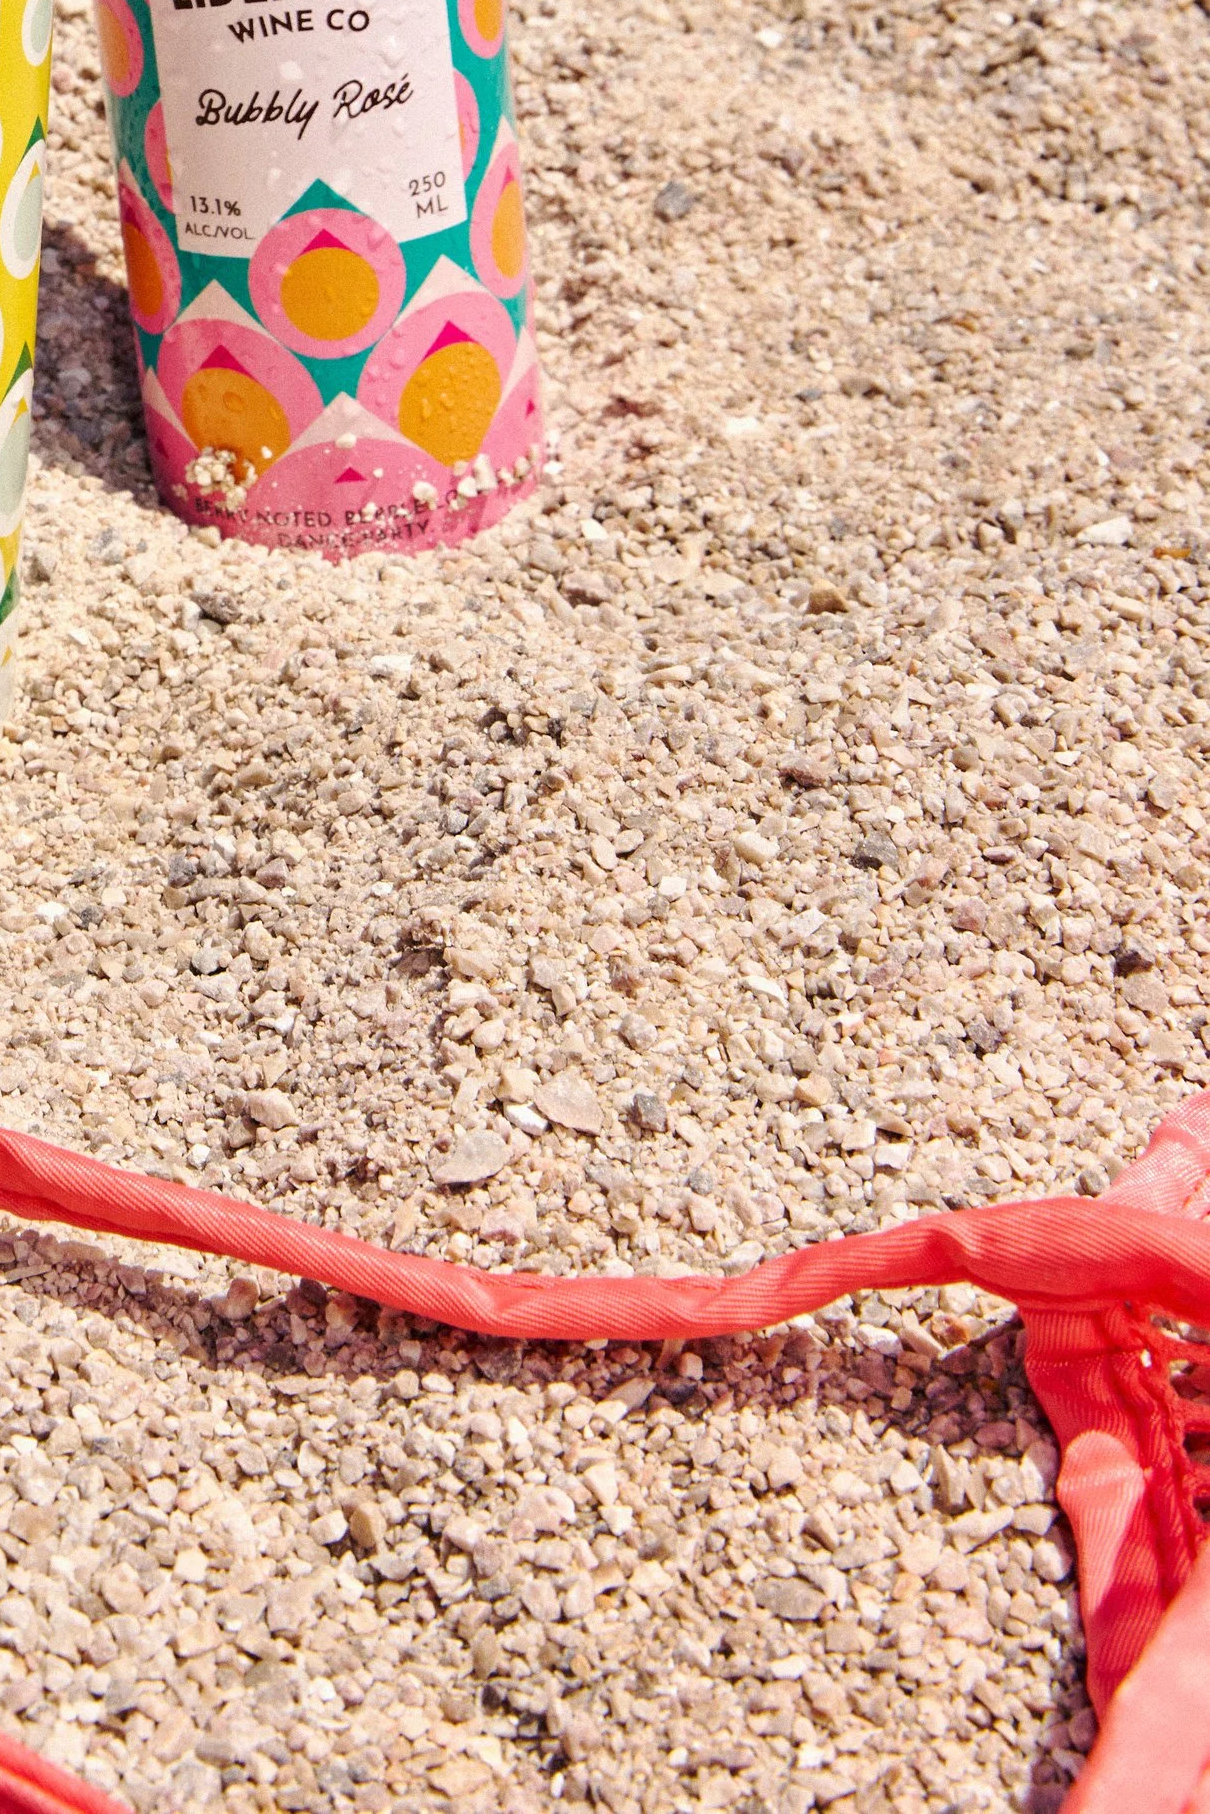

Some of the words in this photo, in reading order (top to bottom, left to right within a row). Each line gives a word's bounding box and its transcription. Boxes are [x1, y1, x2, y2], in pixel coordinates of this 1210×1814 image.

[227, 10, 314, 43] WINE
[325, 8, 371, 33] CO
[194, 88, 320, 141] Bubbly
[332, 73, 414, 120] Rosé
[408, 171, 446, 197] 250
[190, 195, 242, 217] 13.1%
[416, 193, 449, 219] ML
